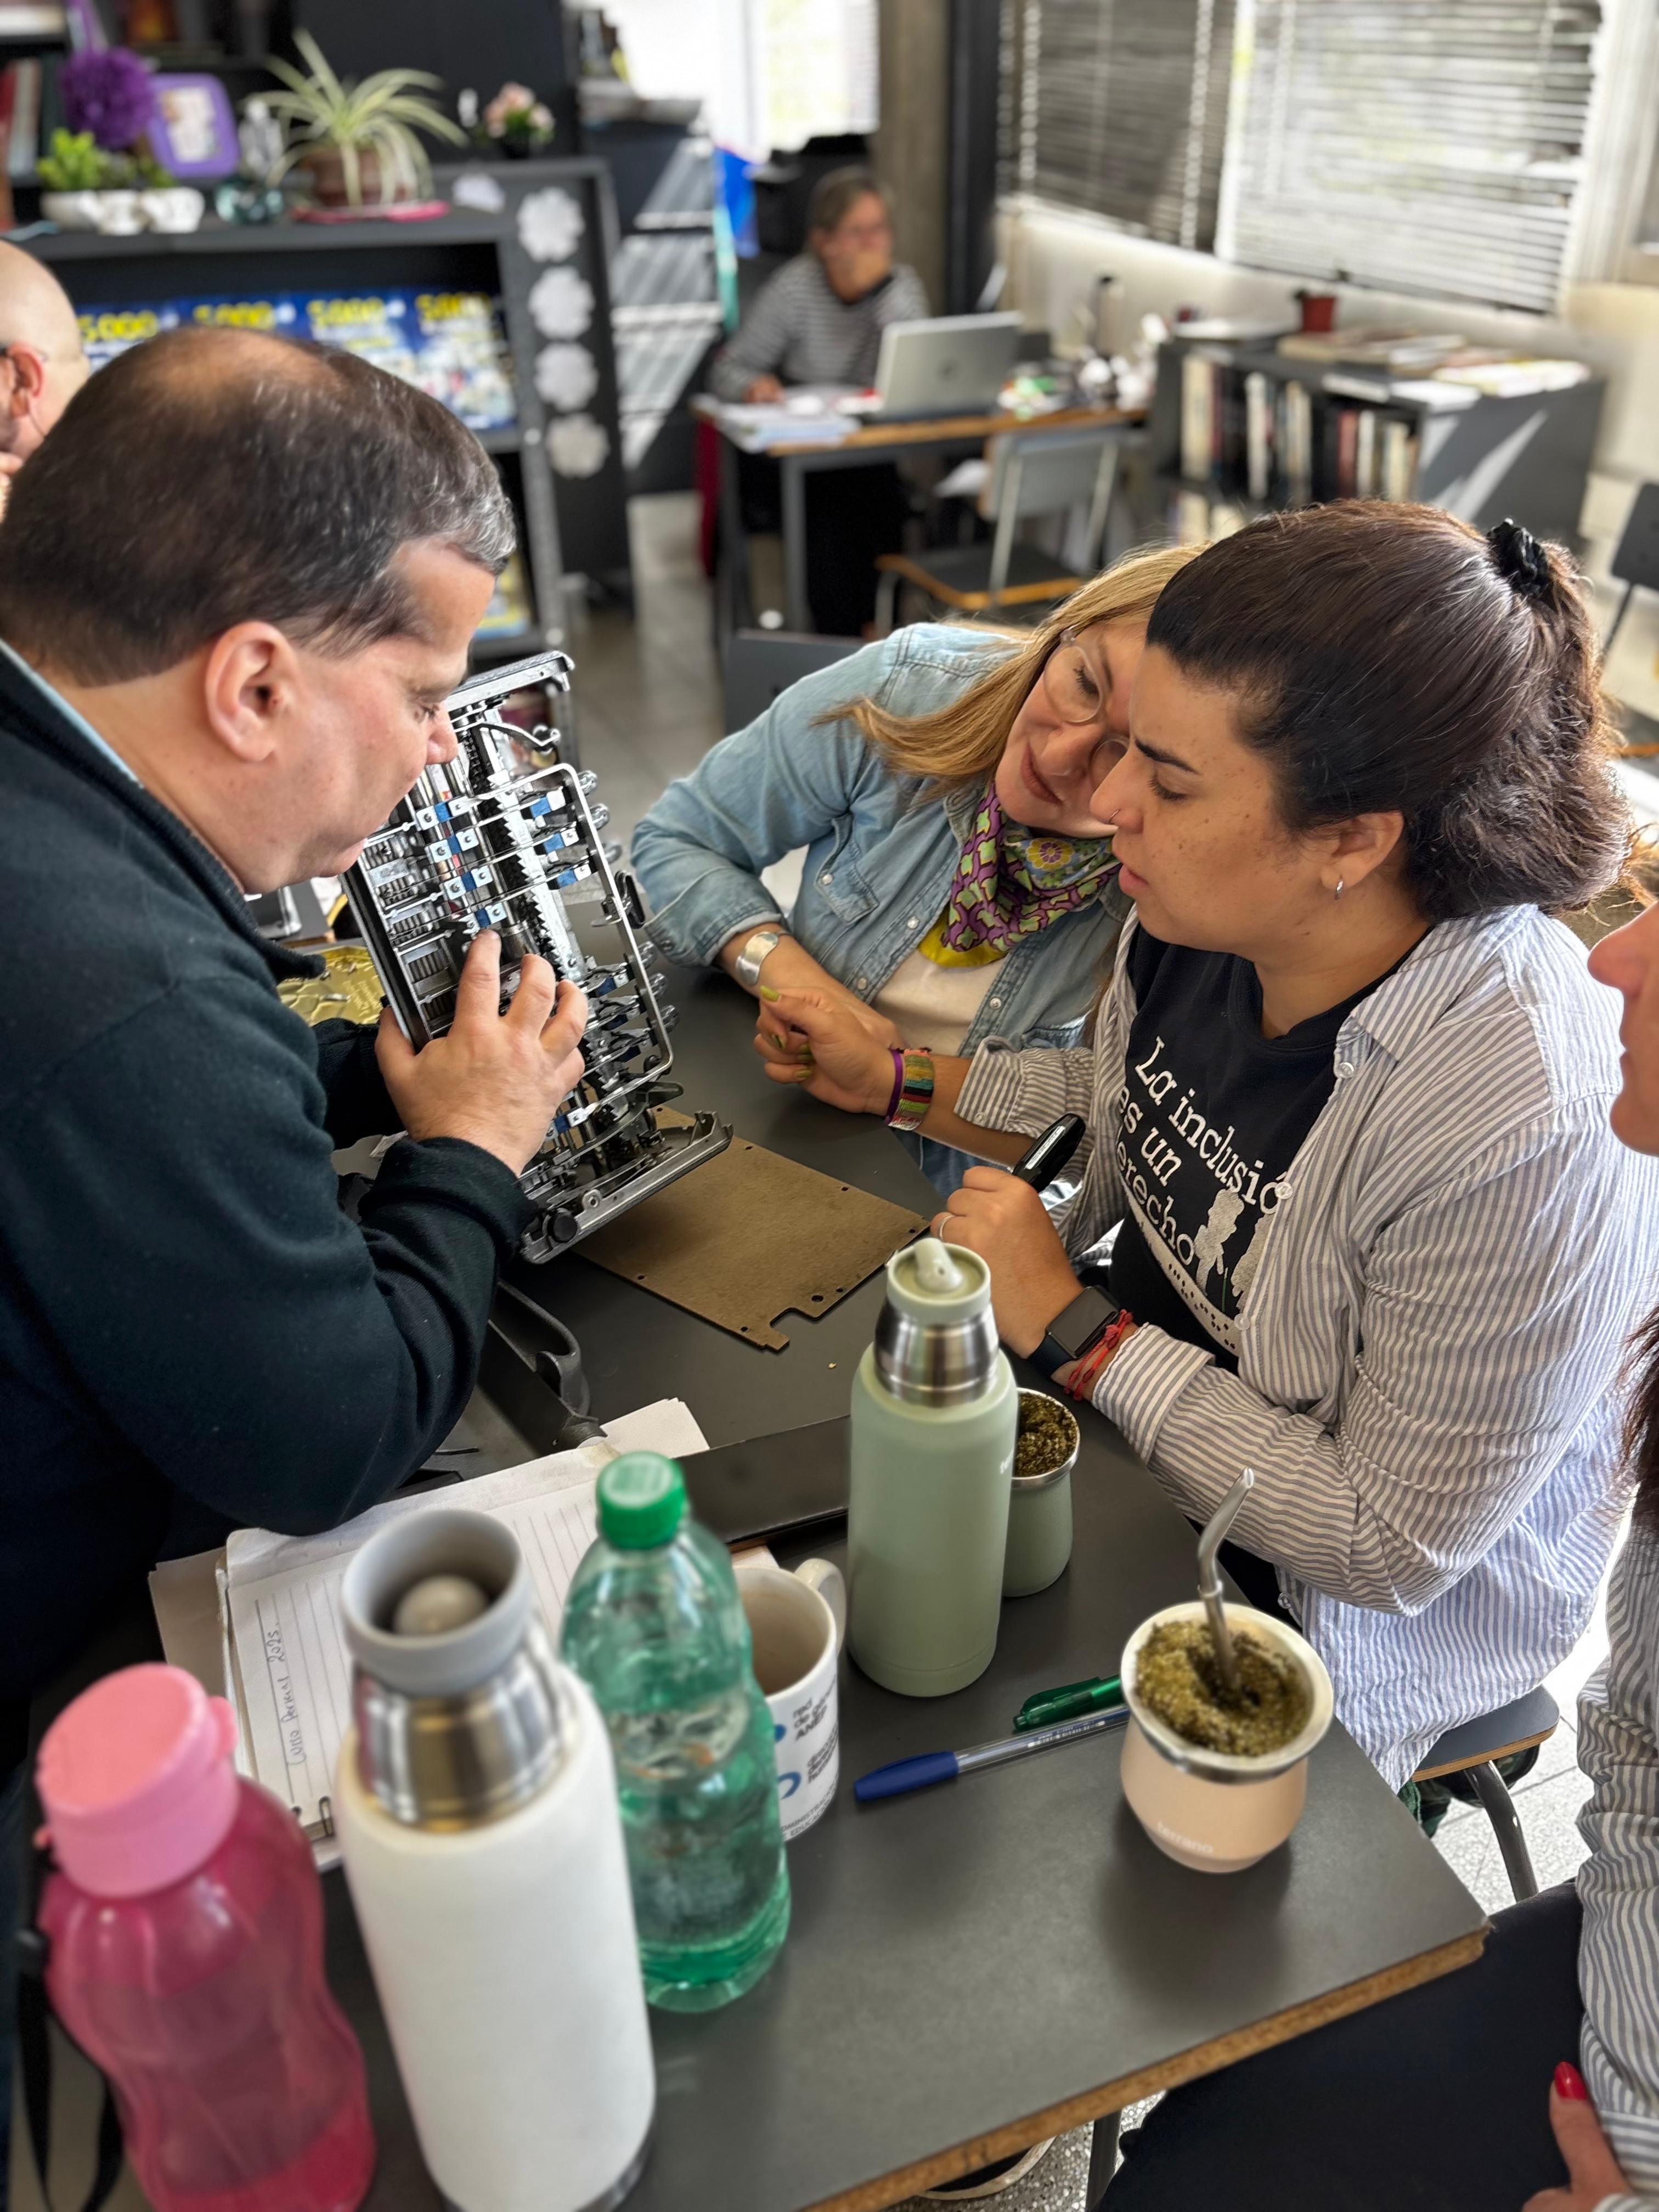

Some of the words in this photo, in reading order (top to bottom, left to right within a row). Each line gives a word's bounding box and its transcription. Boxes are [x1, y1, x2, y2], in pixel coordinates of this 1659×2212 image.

[1135, 1036, 1178, 1106] La
[1168, 1088, 1288, 1215] inclusió
[1141, 1126, 1182, 1187] un
[1115, 1126, 1195, 1265] erecho
